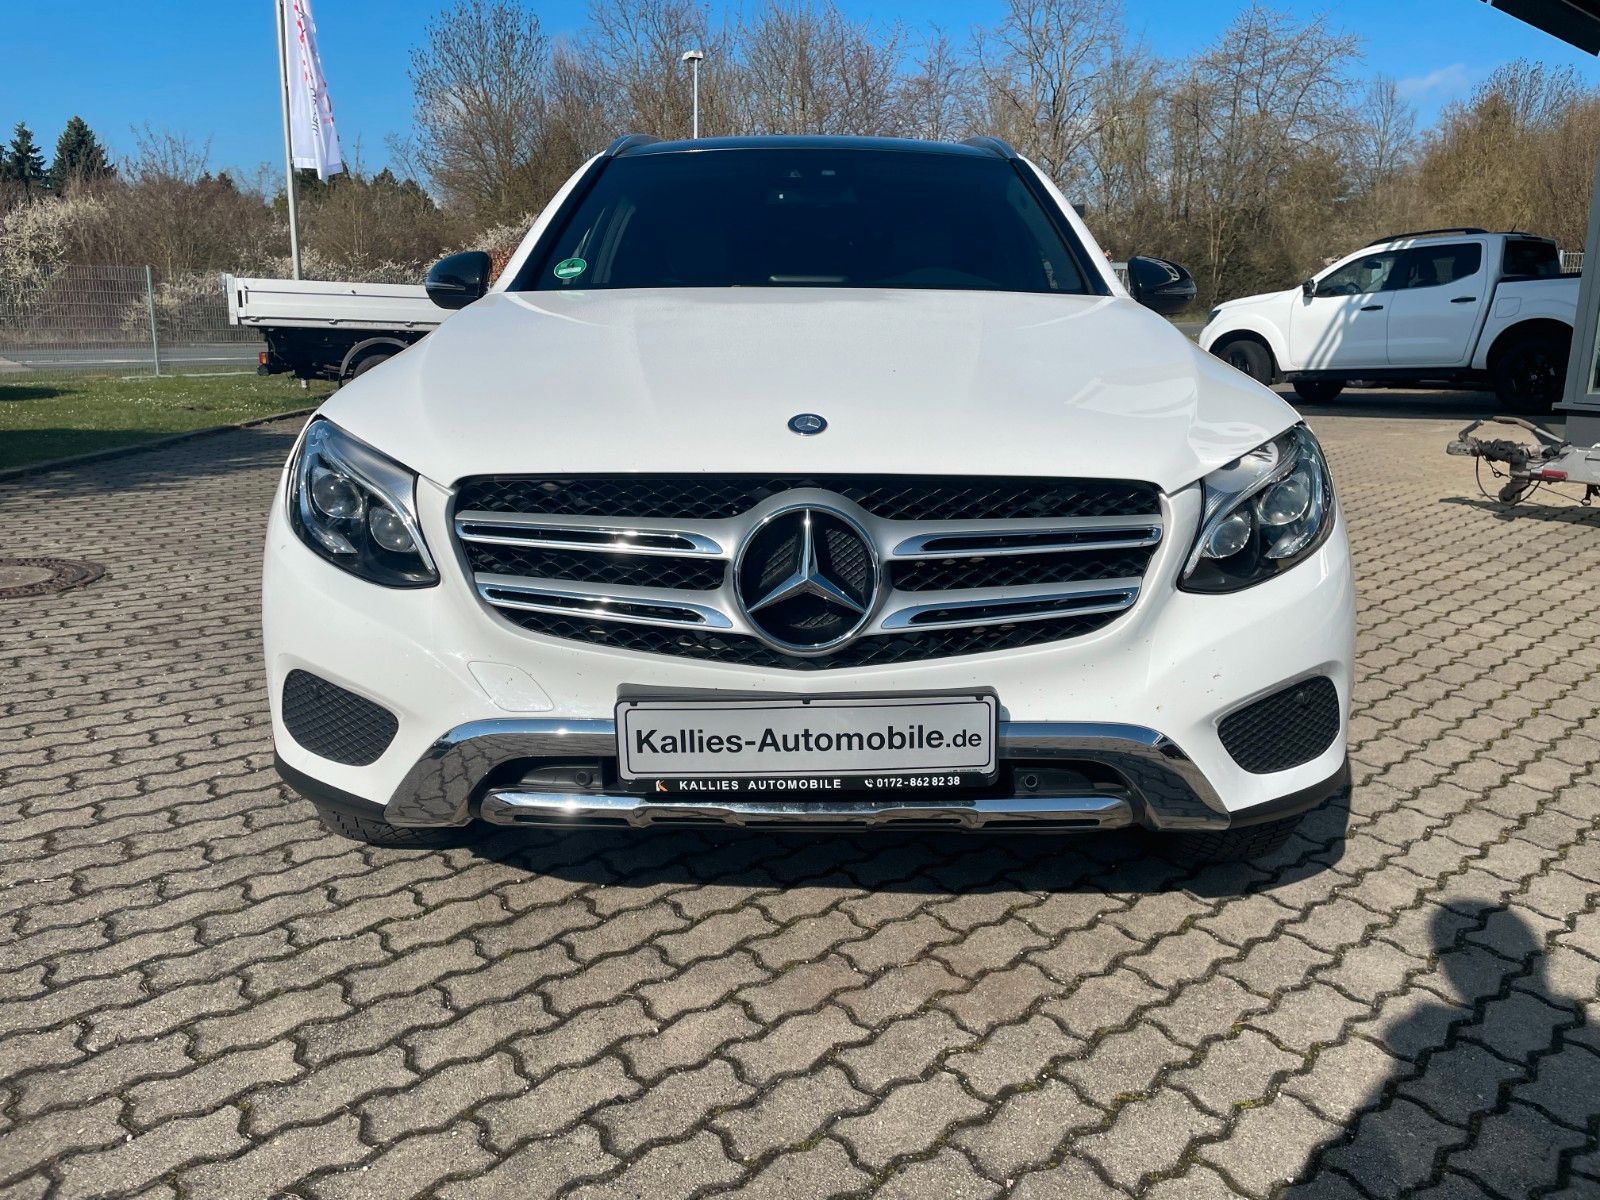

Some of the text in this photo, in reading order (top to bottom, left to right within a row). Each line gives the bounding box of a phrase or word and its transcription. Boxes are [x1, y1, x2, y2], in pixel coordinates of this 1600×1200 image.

[635, 725, 982, 754] Kallies-Automobile.de
[679, 779, 842, 790] KALLIES AUTOMOBILE
[876, 776, 960, 787] 0172-862 82 38
